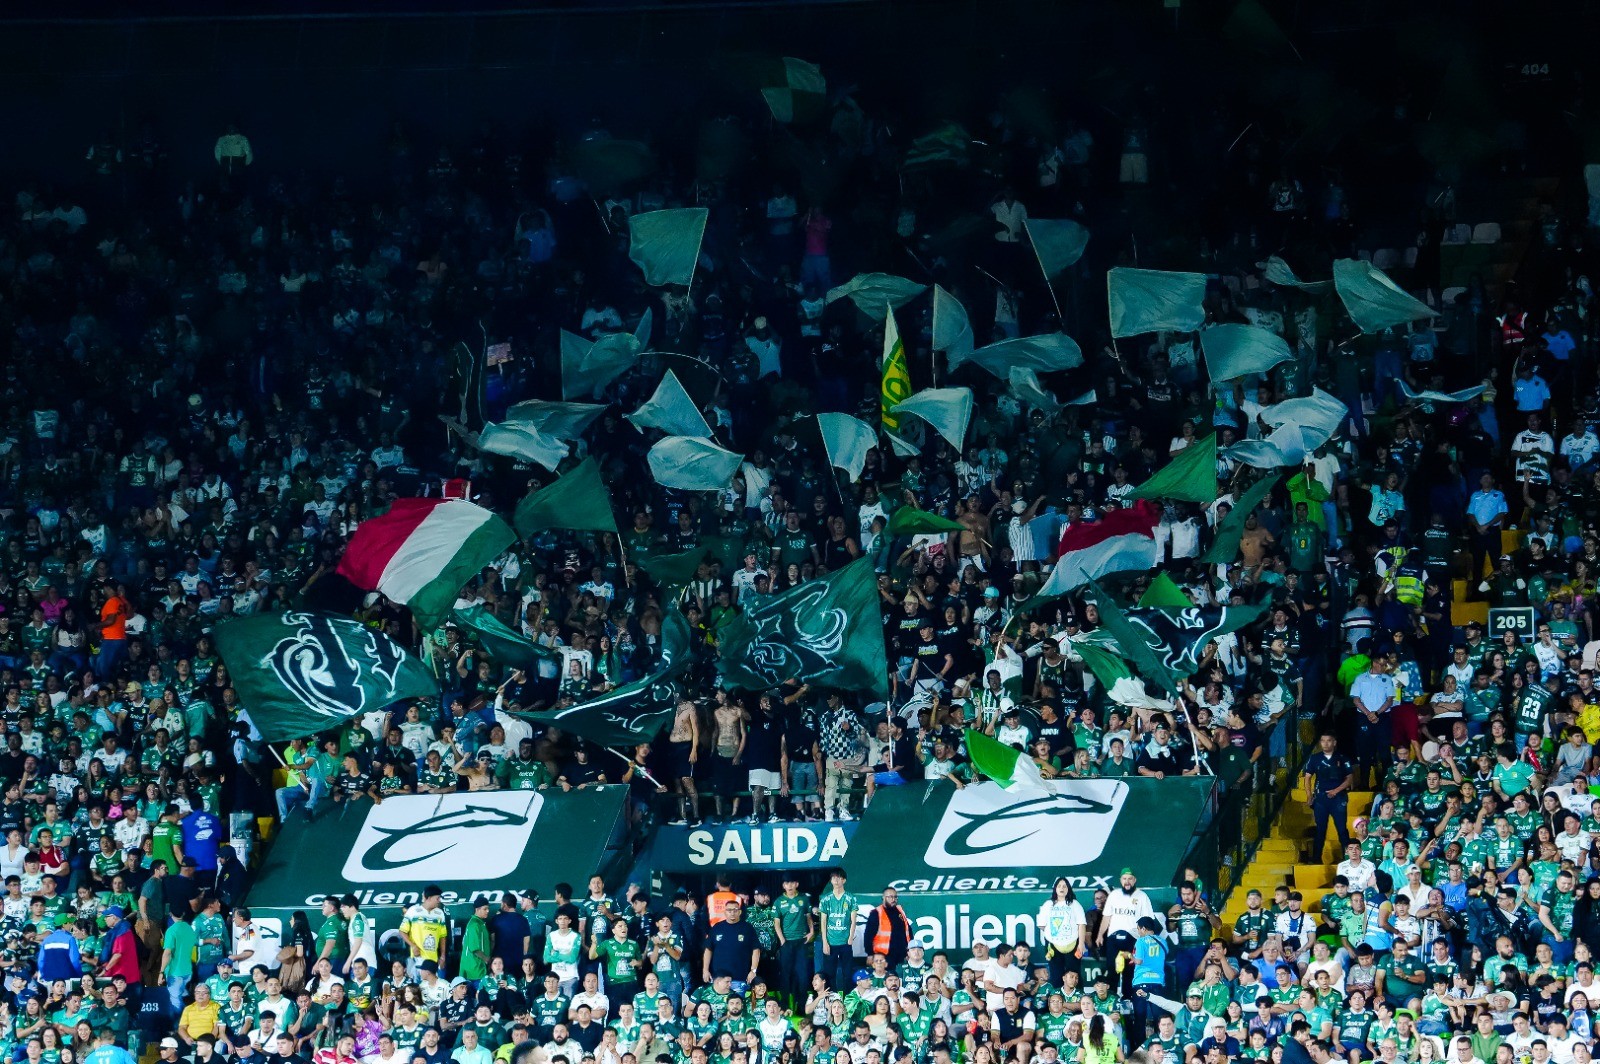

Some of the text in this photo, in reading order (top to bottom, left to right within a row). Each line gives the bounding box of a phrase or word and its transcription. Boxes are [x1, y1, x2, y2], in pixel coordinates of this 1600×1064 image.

[1521, 63, 1549, 75] 404
[1496, 615, 1527, 629] 205
[1521, 696, 1541, 720] 23
[688, 826, 849, 866] SALIDA
[1084, 967, 1109, 982] 10
[140, 1002, 160, 1012] 203
